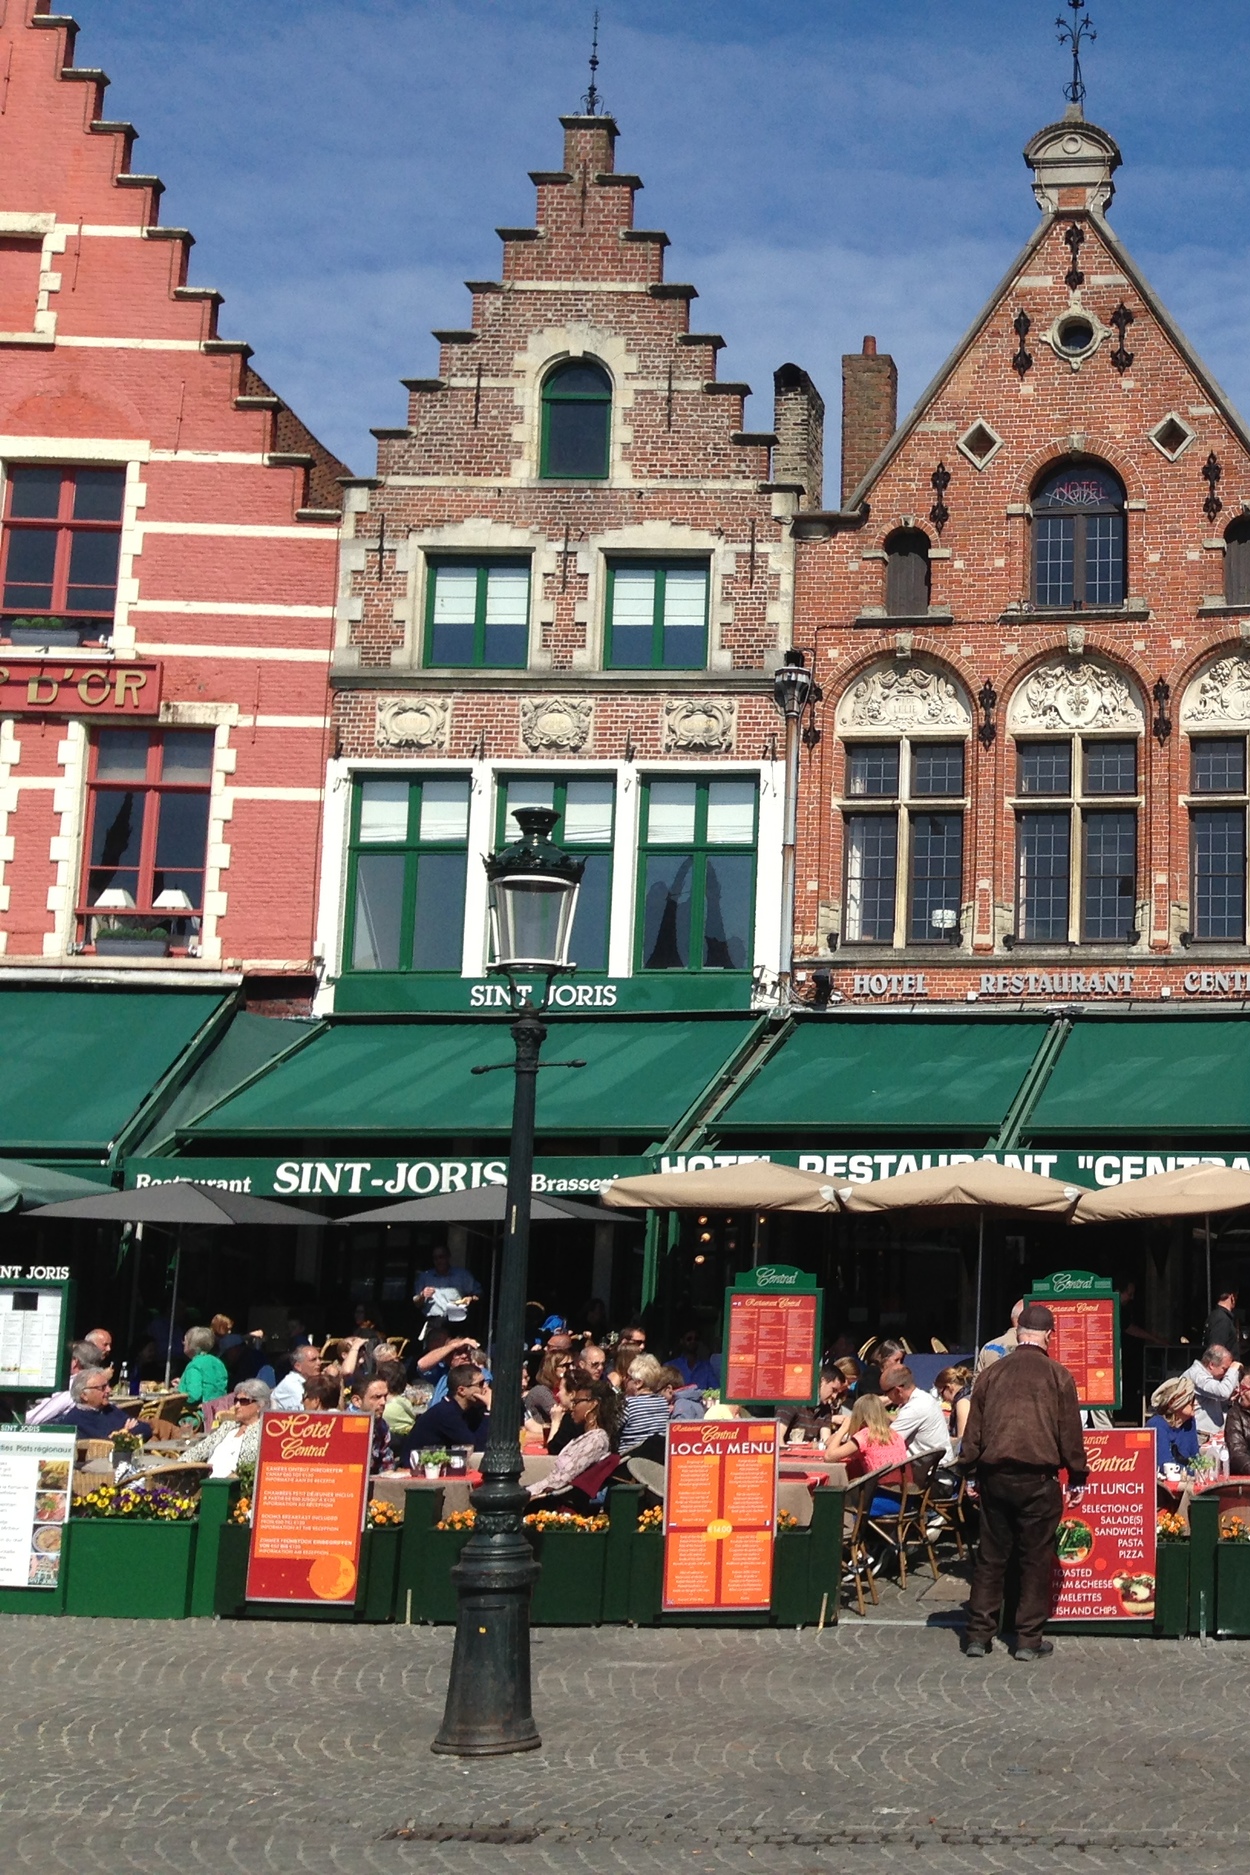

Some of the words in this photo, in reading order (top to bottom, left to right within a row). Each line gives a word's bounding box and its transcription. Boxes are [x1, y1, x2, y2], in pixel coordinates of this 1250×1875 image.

[27, 668, 148, 708] D'OR
[852, 973, 928, 995] HOTEL
[980, 972, 1134, 994] RESTAURANT
[470, 985, 533, 1007] SINT
[540, 985, 618, 1007] JORIS
[661, 1155, 771, 1175] HOT
[799, 1154, 1058, 1185] RESTANT
[136, 1173, 252, 1194] Rtrant
[274, 1161, 508, 1194] SINT-JORIS
[26, 1266, 70, 1280] JORIS
[756, 1267, 799, 1286] Central
[1053, 1273, 1095, 1292] Central
[19, 1425, 41, 1433] JORIS
[266, 1413, 337, 1439] Hotel
[700, 1425, 740, 1443] Central
[16, 1444, 33, 1452] Plats
[280, 1438, 330, 1460] Central
[671, 1443, 723, 1455] LOCAL
[727, 1442, 774, 1455] MENU
[1062, 1482, 1099, 1495] LHT
[1101, 1482, 1144, 1495] LUNCH
[1082, 1504, 1129, 1514] SELECTION
[1130, 1504, 1144, 1513] OF
[1101, 1515, 1144, 1526] SALADE(S)
[1094, 1527, 1144, 1536] SANDWICH
[1118, 1538, 1144, 1547] PASTA
[1119, 1549, 1144, 1559] PIZZA
[1053, 1568, 1092, 1577] TOASTED
[1052, 1580, 1073, 1589] HAM
[1081, 1580, 1113, 1589] CHEESE
[1052, 1593, 1102, 1602] OMELETTES
[1071, 1606, 1091, 1615] AND
[1092, 1606, 1117, 1615] CHIPS
